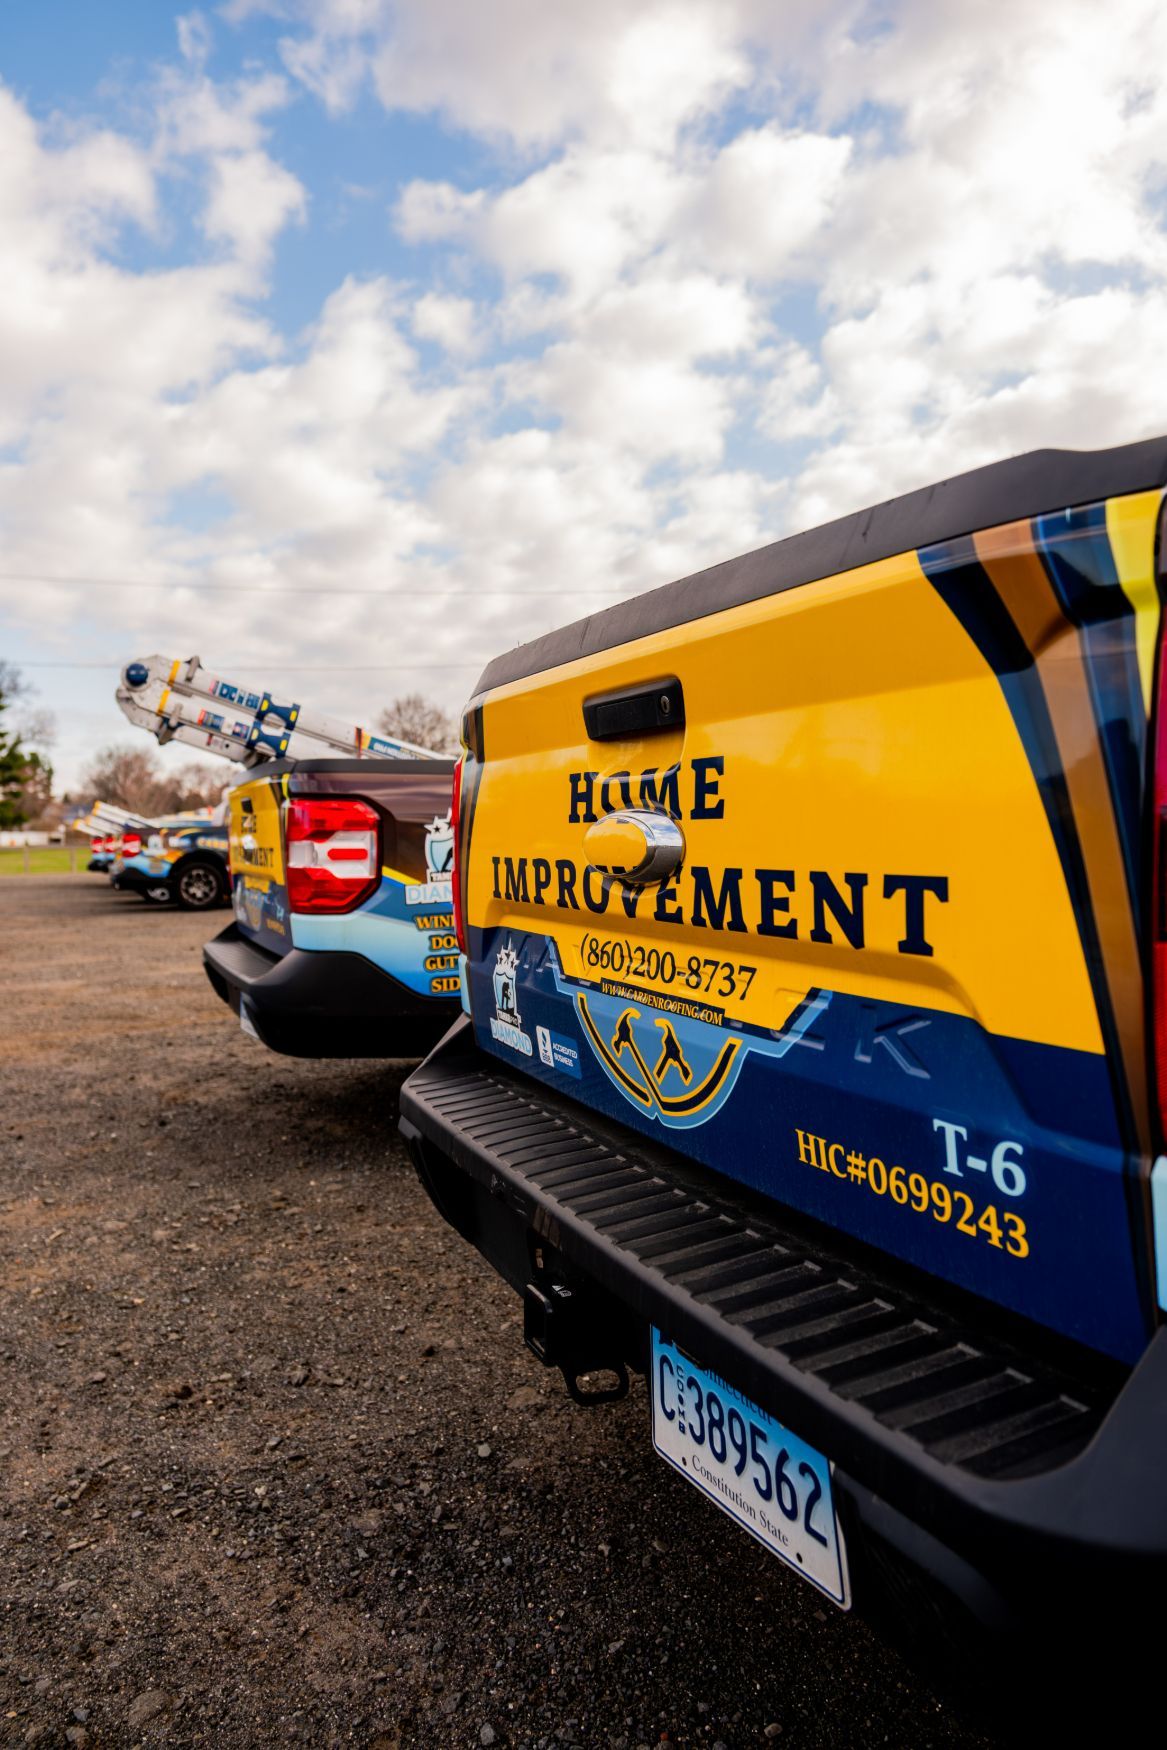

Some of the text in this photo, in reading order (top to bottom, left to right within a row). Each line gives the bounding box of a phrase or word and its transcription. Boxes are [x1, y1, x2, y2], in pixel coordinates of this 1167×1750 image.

[569, 756, 725, 823] HOME
[431, 935, 458, 950] DO
[492, 857, 949, 957] IMPROVEMENT
[580, 933, 757, 1001] (860)200-8737
[492, 1020, 532, 1054] DIAMOND
[795, 1128, 1030, 1258] HIC#0699243
[933, 1118, 1027, 1197] T-6
[692, 1454, 790, 1548] Constitution State
